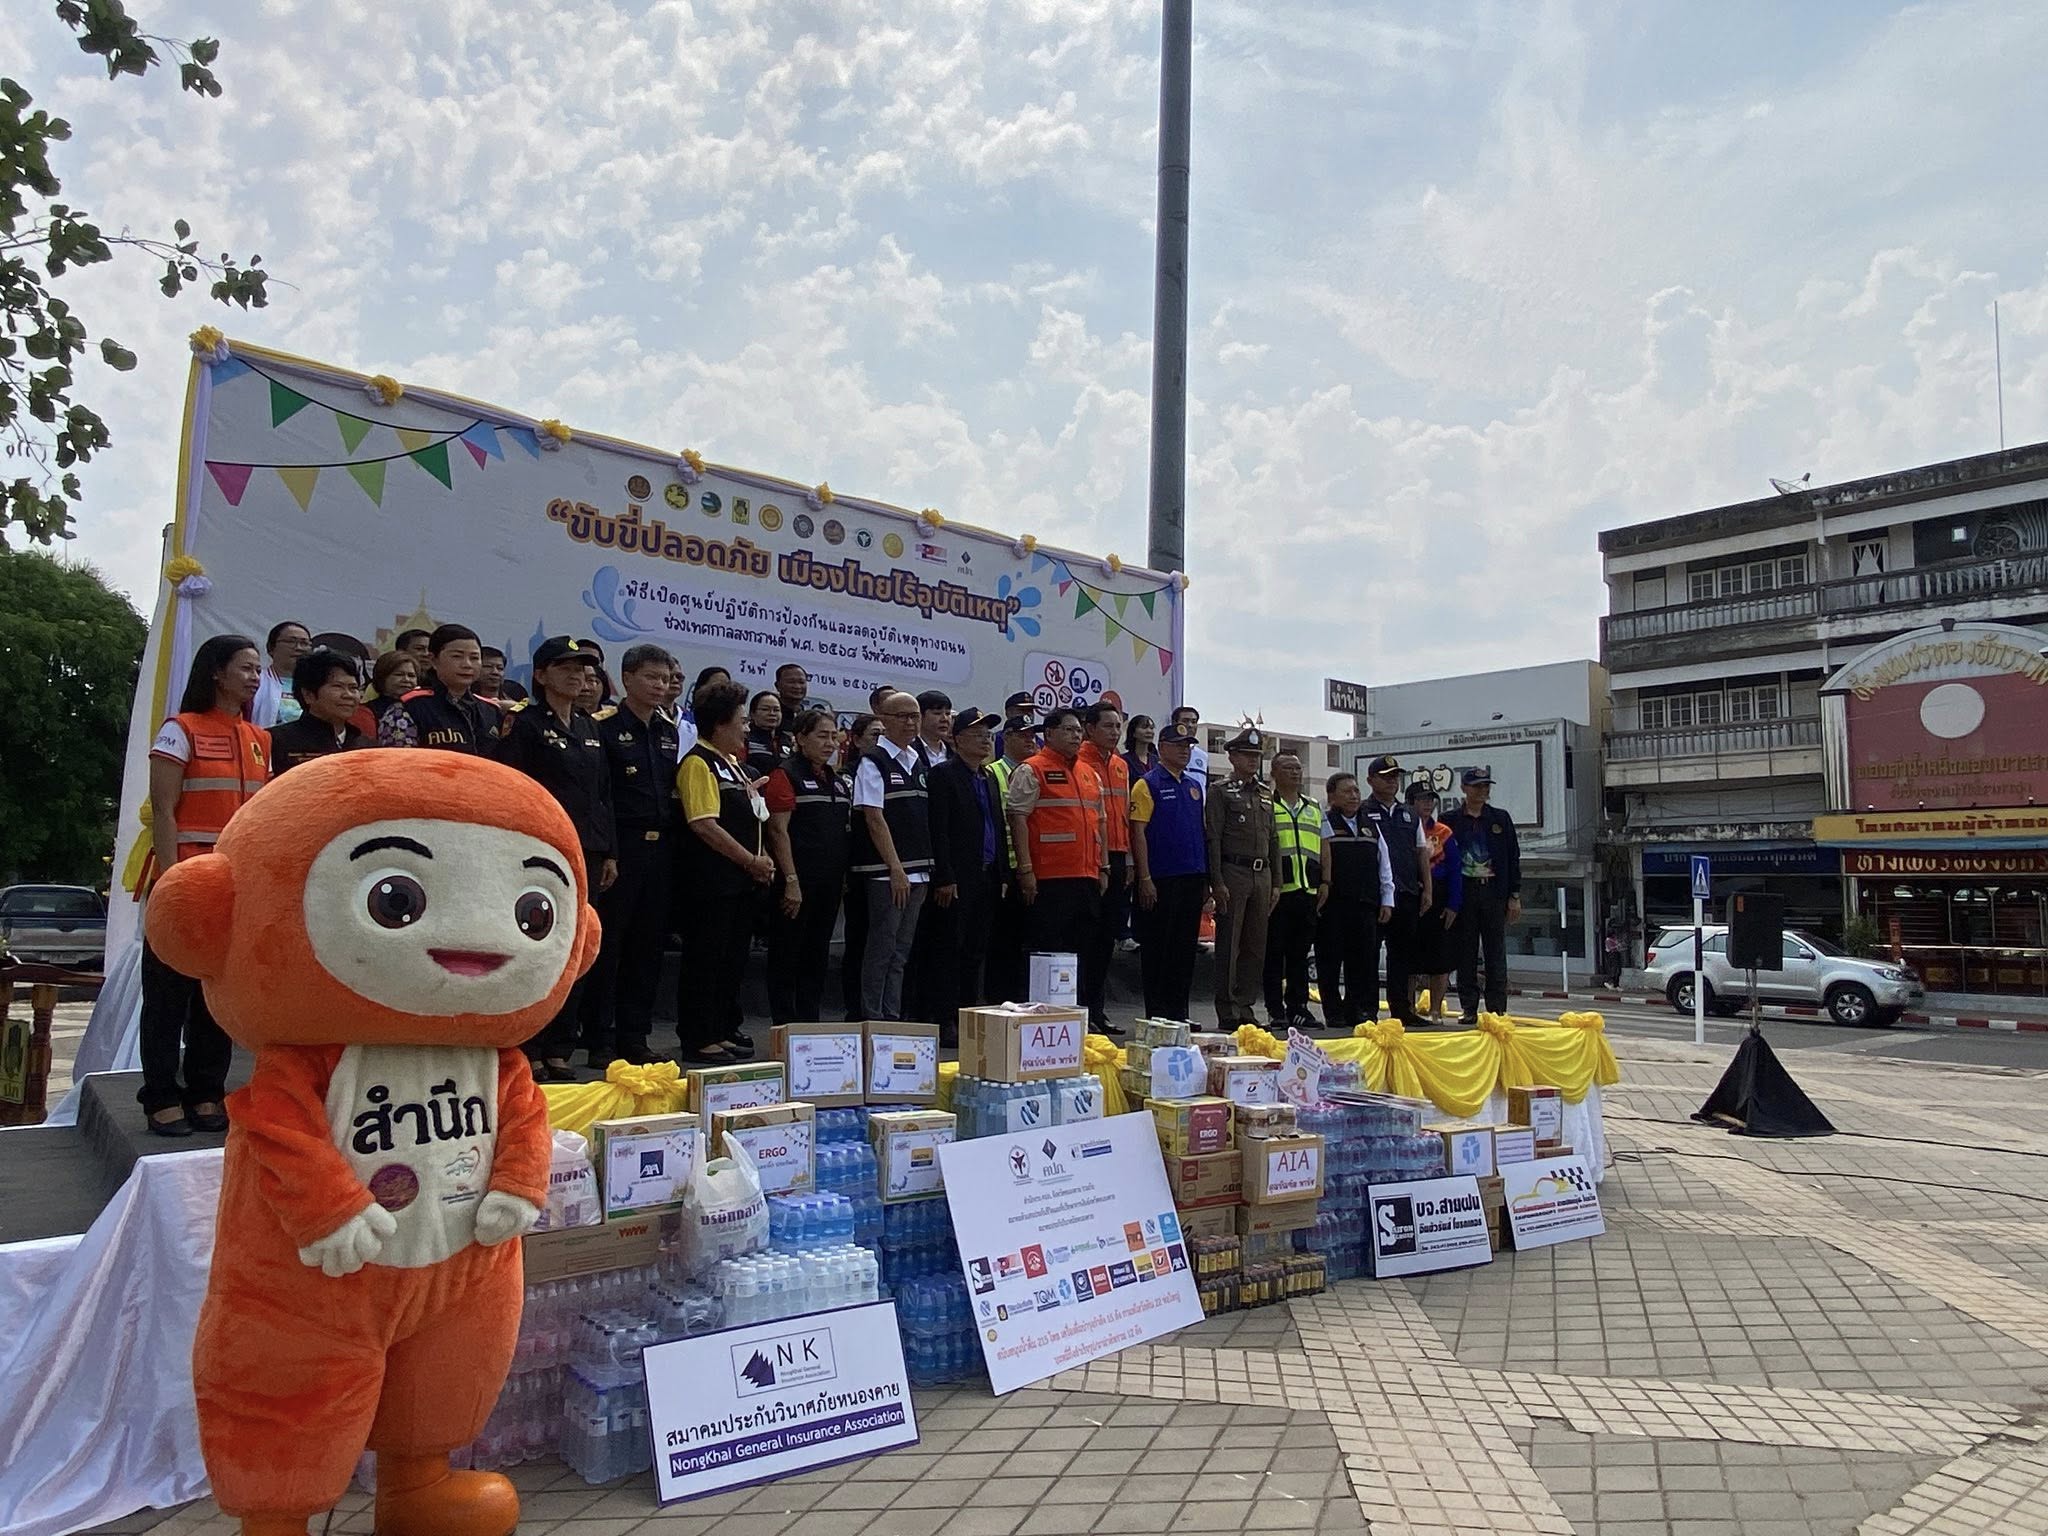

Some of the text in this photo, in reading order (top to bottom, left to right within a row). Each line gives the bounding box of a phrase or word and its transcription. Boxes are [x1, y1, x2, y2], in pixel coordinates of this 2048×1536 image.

[547, 498, 772, 578] “ขับขี่ปลอดภัย
[664, 611, 938, 672] ช่วงเทศกาลสงกรานต์ พ.ศ. ๒๕๖๘ จังหวัดหนองคาย
[739, 659, 768, 676] วันที่
[1038, 692, 1052, 705] 50
[1031, 1025, 1071, 1048] AIA
[353, 1078, 491, 1154] สำนึก
[759, 1146, 787, 1159] ERGO
[1277, 1149, 1309, 1172] AIA
[640, 1163, 659, 1177] AXA
[1034, 1288, 1057, 1304] TQM
[666, 1382, 900, 1446] สมาคมประกันวินาศภัยหนองคาย
[672, 1409, 904, 1473] NongKhai General Insurance Association
